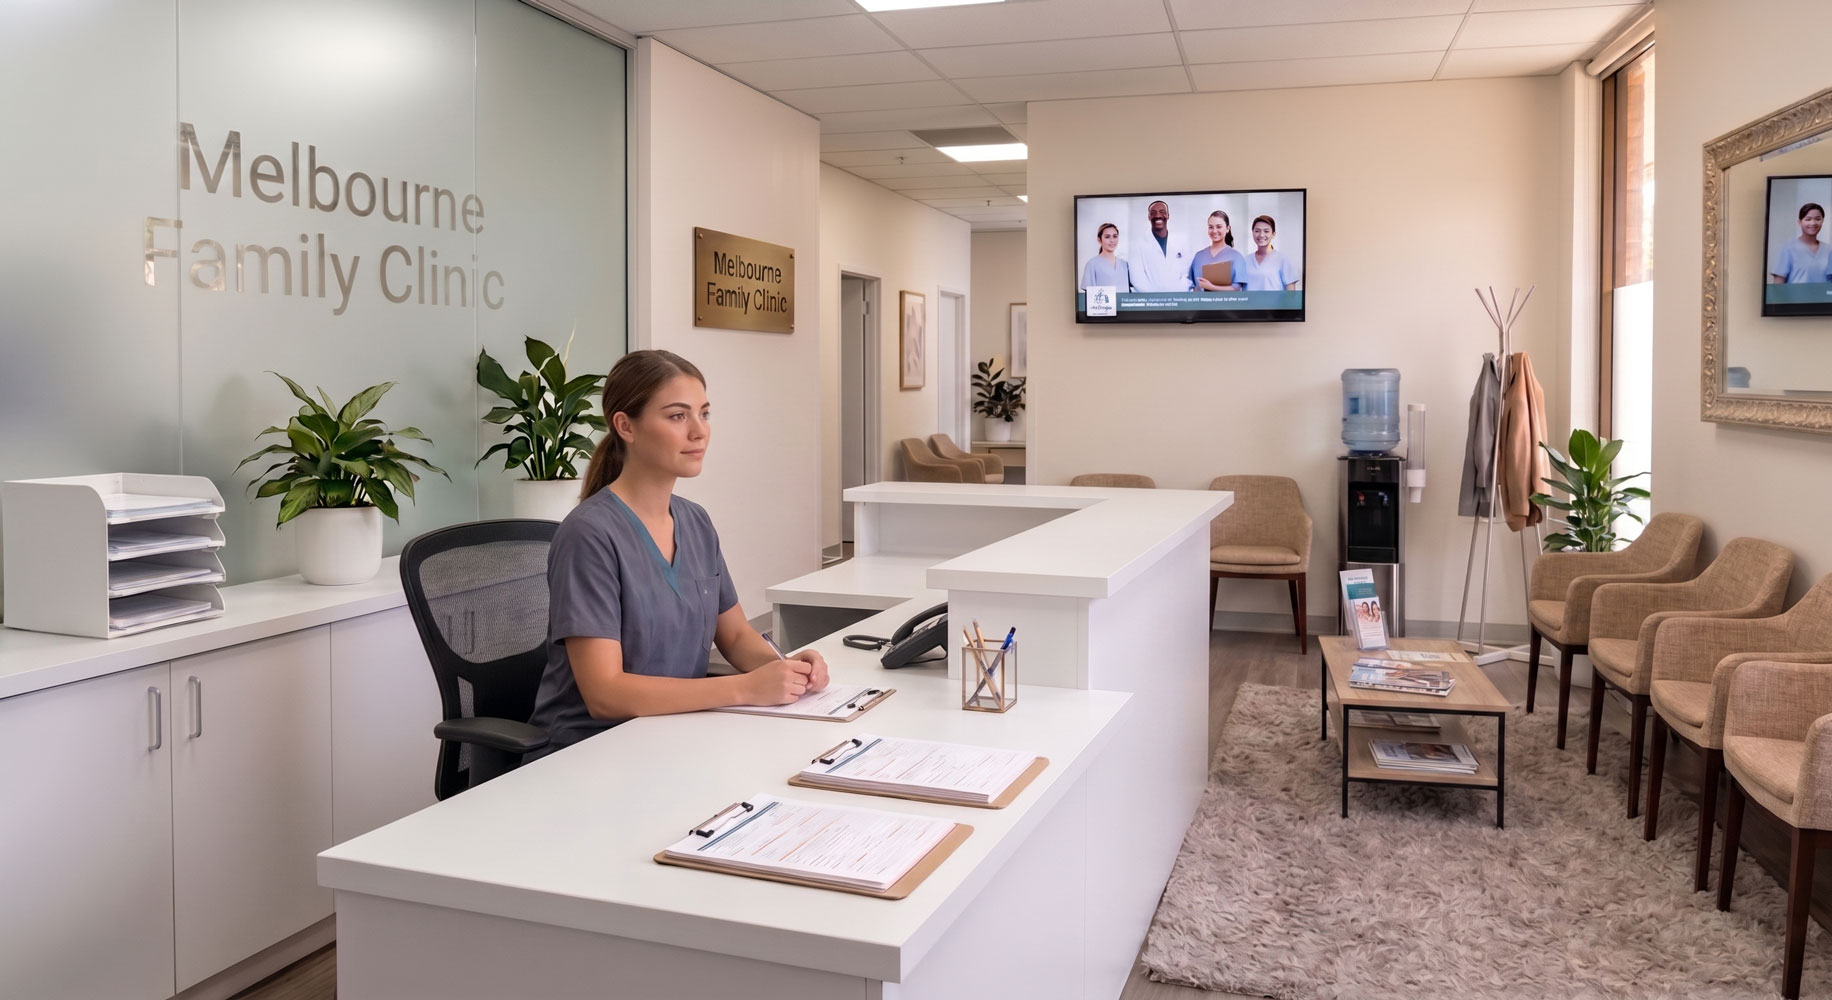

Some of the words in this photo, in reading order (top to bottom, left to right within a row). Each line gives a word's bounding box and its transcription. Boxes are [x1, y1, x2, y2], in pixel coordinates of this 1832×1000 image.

[179, 121, 485, 234] Melbourne
[143, 216, 360, 316] Family
[380, 244, 505, 310] Clinic
[707, 281, 751, 315] Family
[753, 288, 787, 313] Clinic
[713, 250, 782, 284] Melbourne
